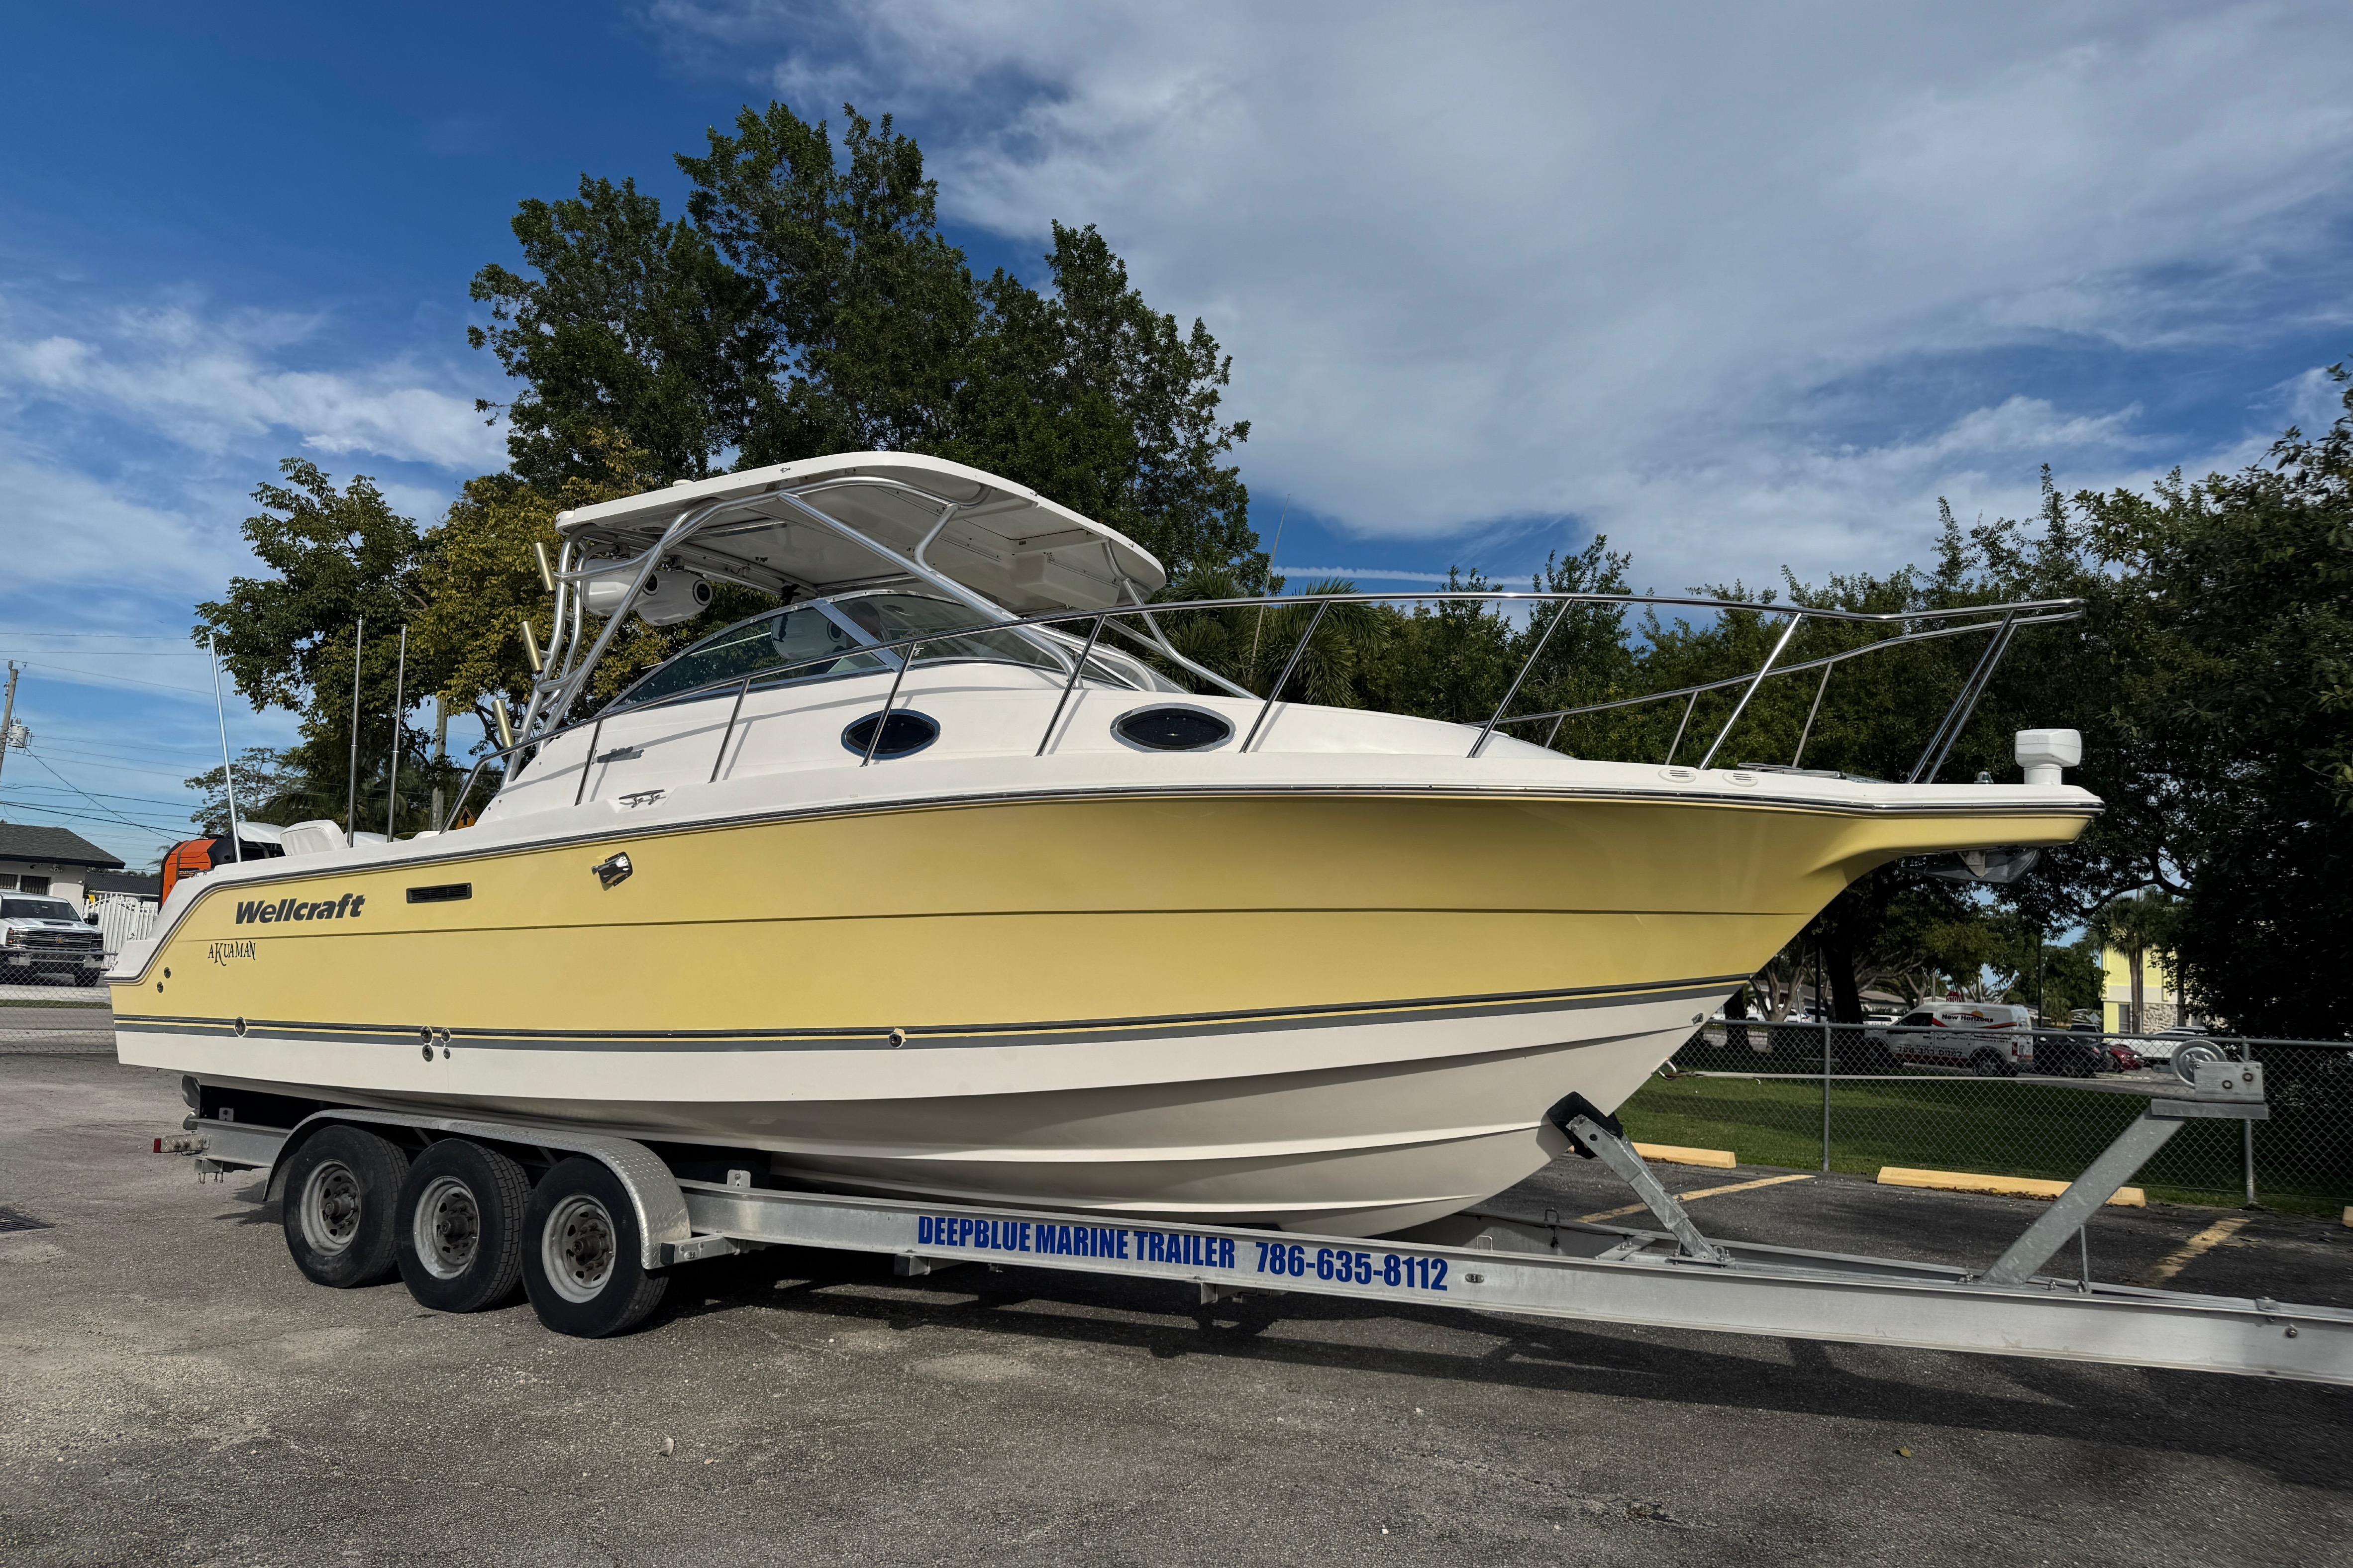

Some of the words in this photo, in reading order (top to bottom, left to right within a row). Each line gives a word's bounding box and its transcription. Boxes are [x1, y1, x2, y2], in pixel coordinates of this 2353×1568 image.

[236, 893, 365, 924] Wellcraft
[207, 940, 256, 966] AKUAMAN
[1960, 1014, 1994, 1022] Horizons
[919, 1216, 1030, 1252] DEEPBLUE
[1035, 1225, 1128, 1259] MARINE
[1134, 1231, 1235, 1268] TRAILER
[1256, 1242, 1448, 1290] 786-635-8112
